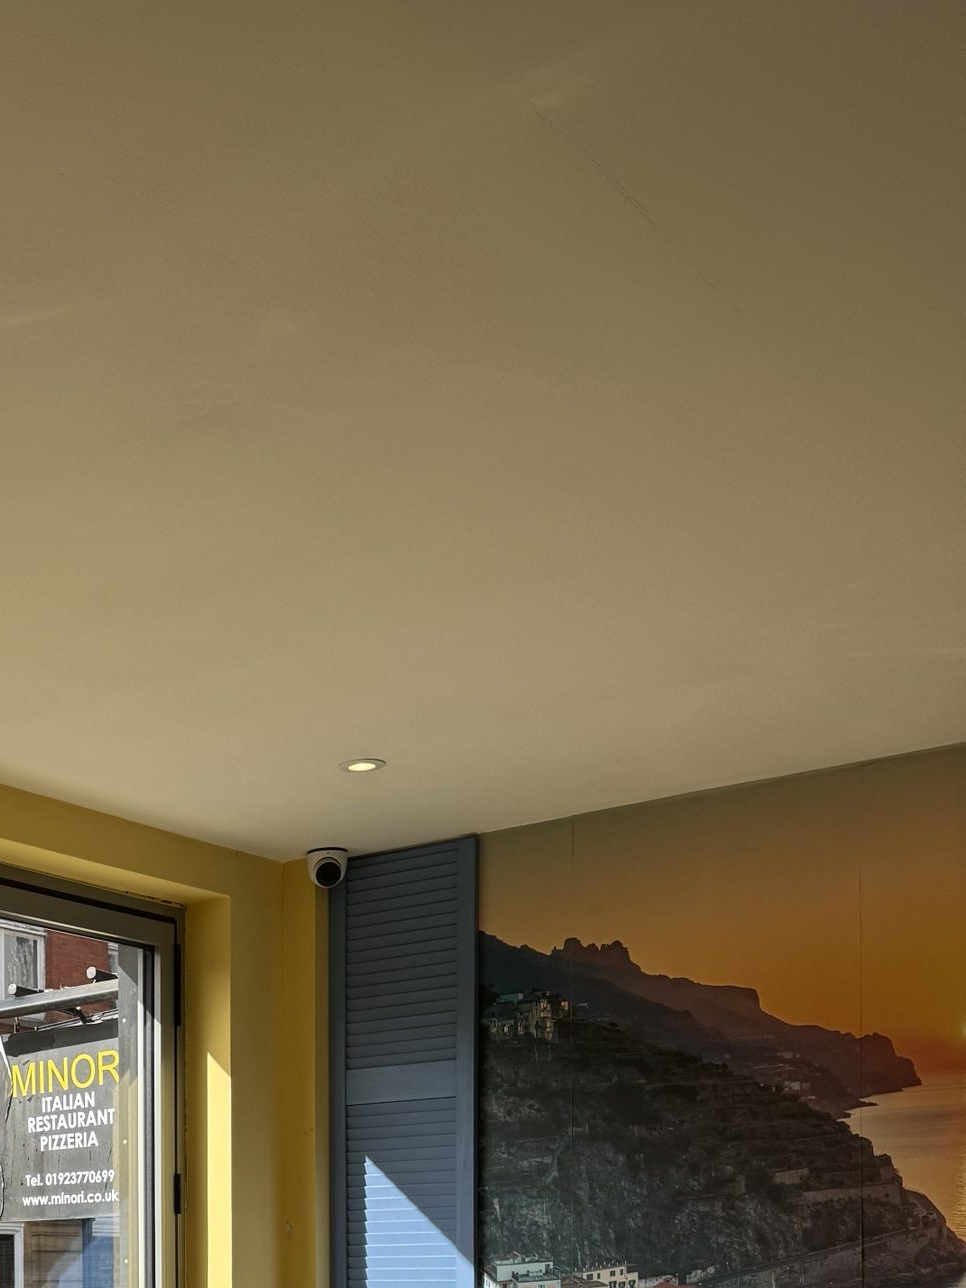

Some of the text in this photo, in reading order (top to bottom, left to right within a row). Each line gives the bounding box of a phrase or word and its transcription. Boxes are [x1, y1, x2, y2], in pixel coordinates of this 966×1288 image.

[12, 1050, 119, 1097] MINOR
[41, 1091, 96, 1113] ITALIAN
[27, 1108, 115, 1133] RESTAURANT
[40, 1131, 99, 1151] PIZZERIA
[25, 1169, 115, 1187] Tel. 01923770699
[22, 1189, 119, 1206] www.minori.co.uk
